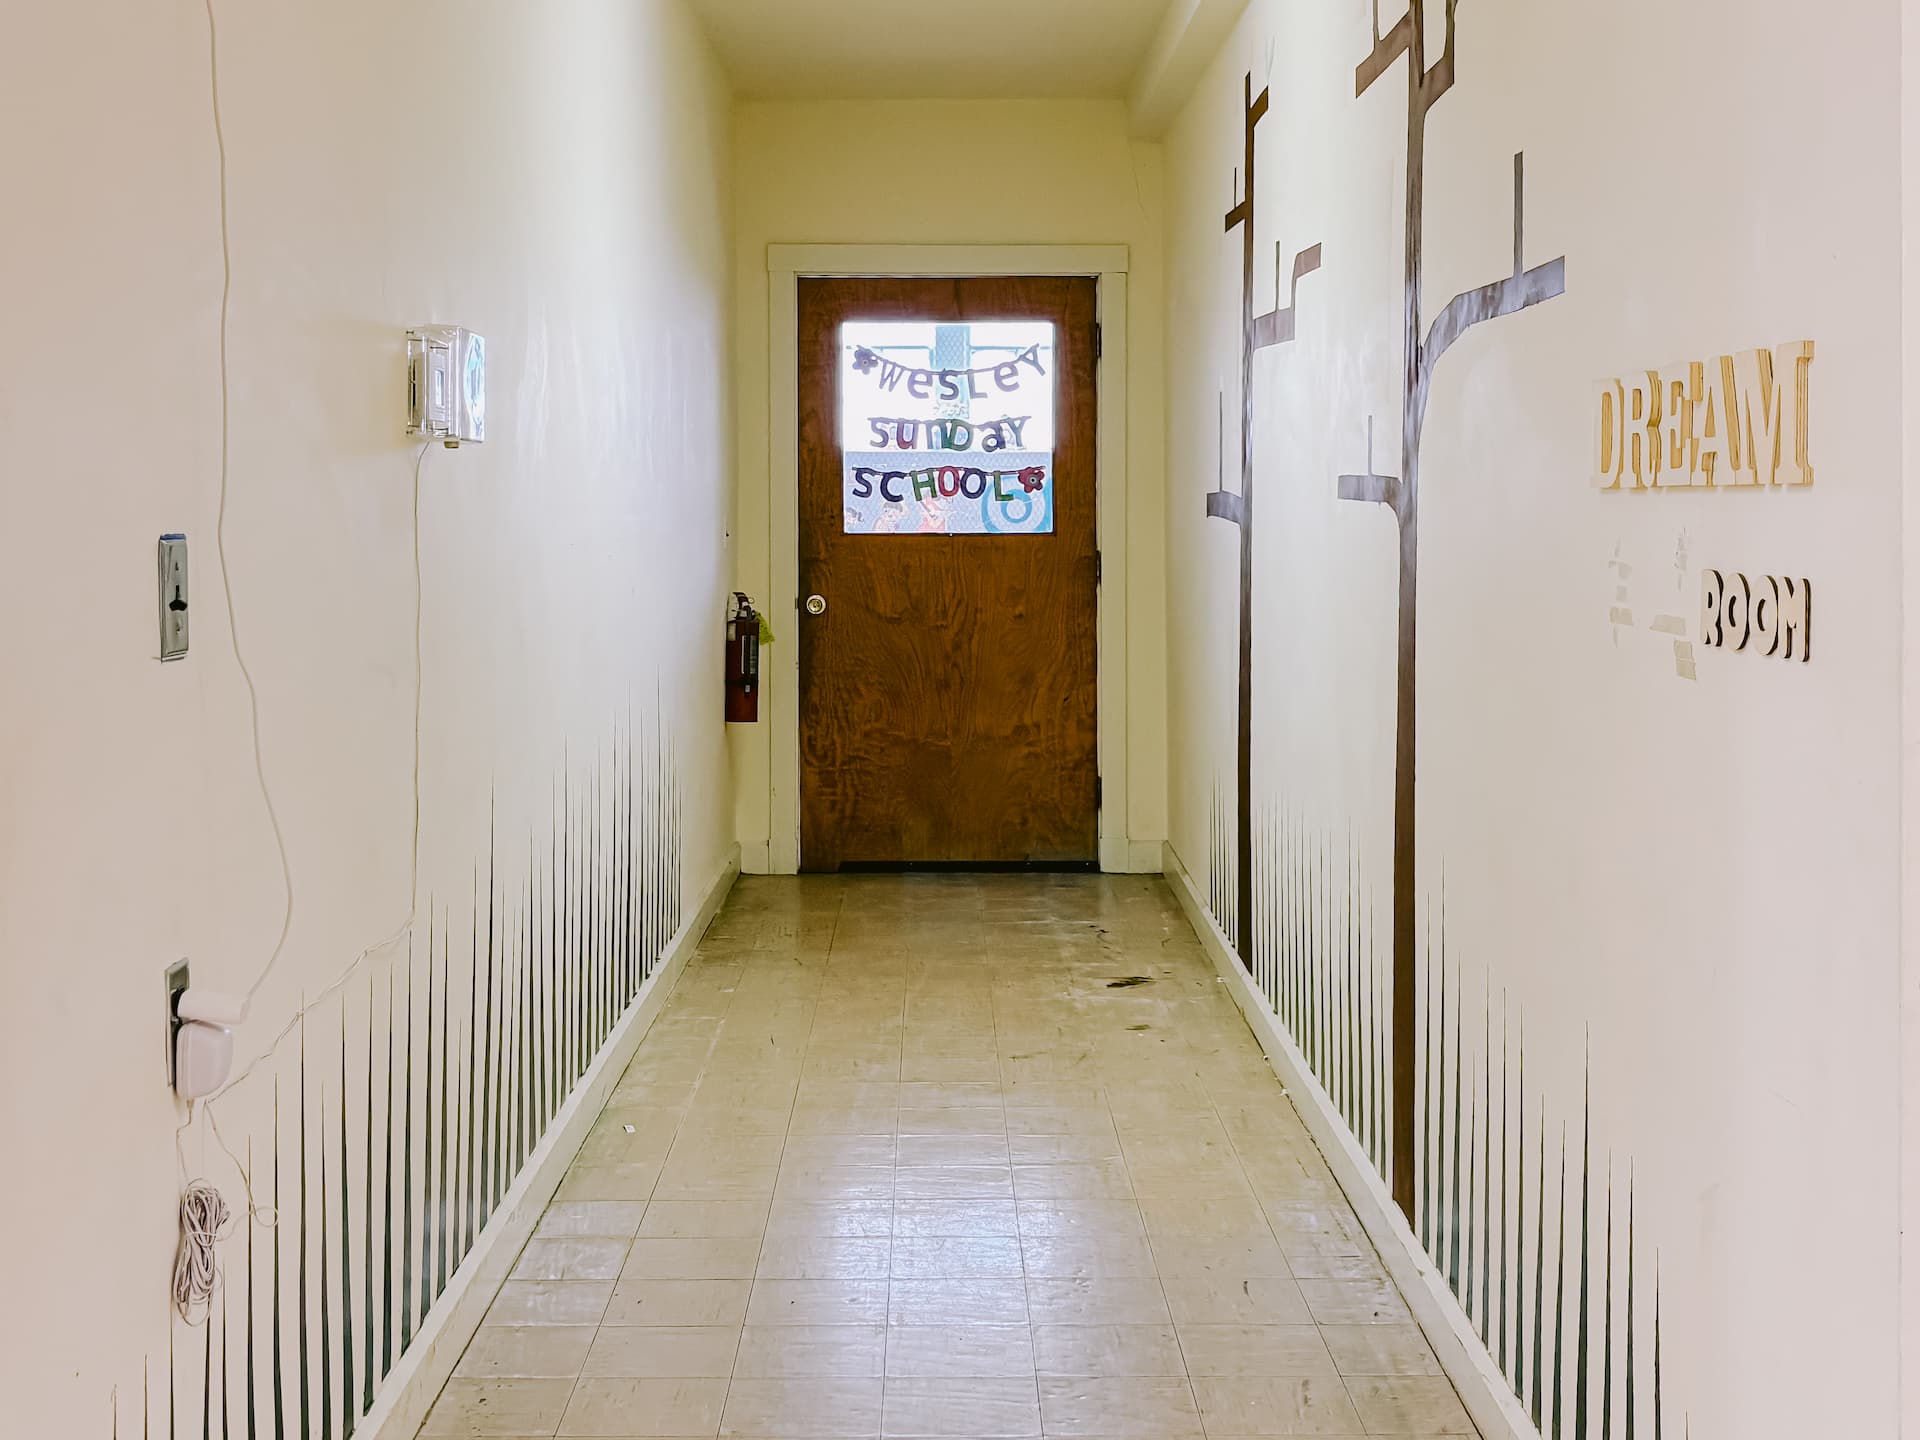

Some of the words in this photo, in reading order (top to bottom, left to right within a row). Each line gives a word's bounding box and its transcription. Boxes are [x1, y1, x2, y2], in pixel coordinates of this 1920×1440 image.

[1591, 340, 1815, 489] DREAM
[852, 466, 1014, 502] SCHOOL
[1701, 569, 1811, 663] ROOM
